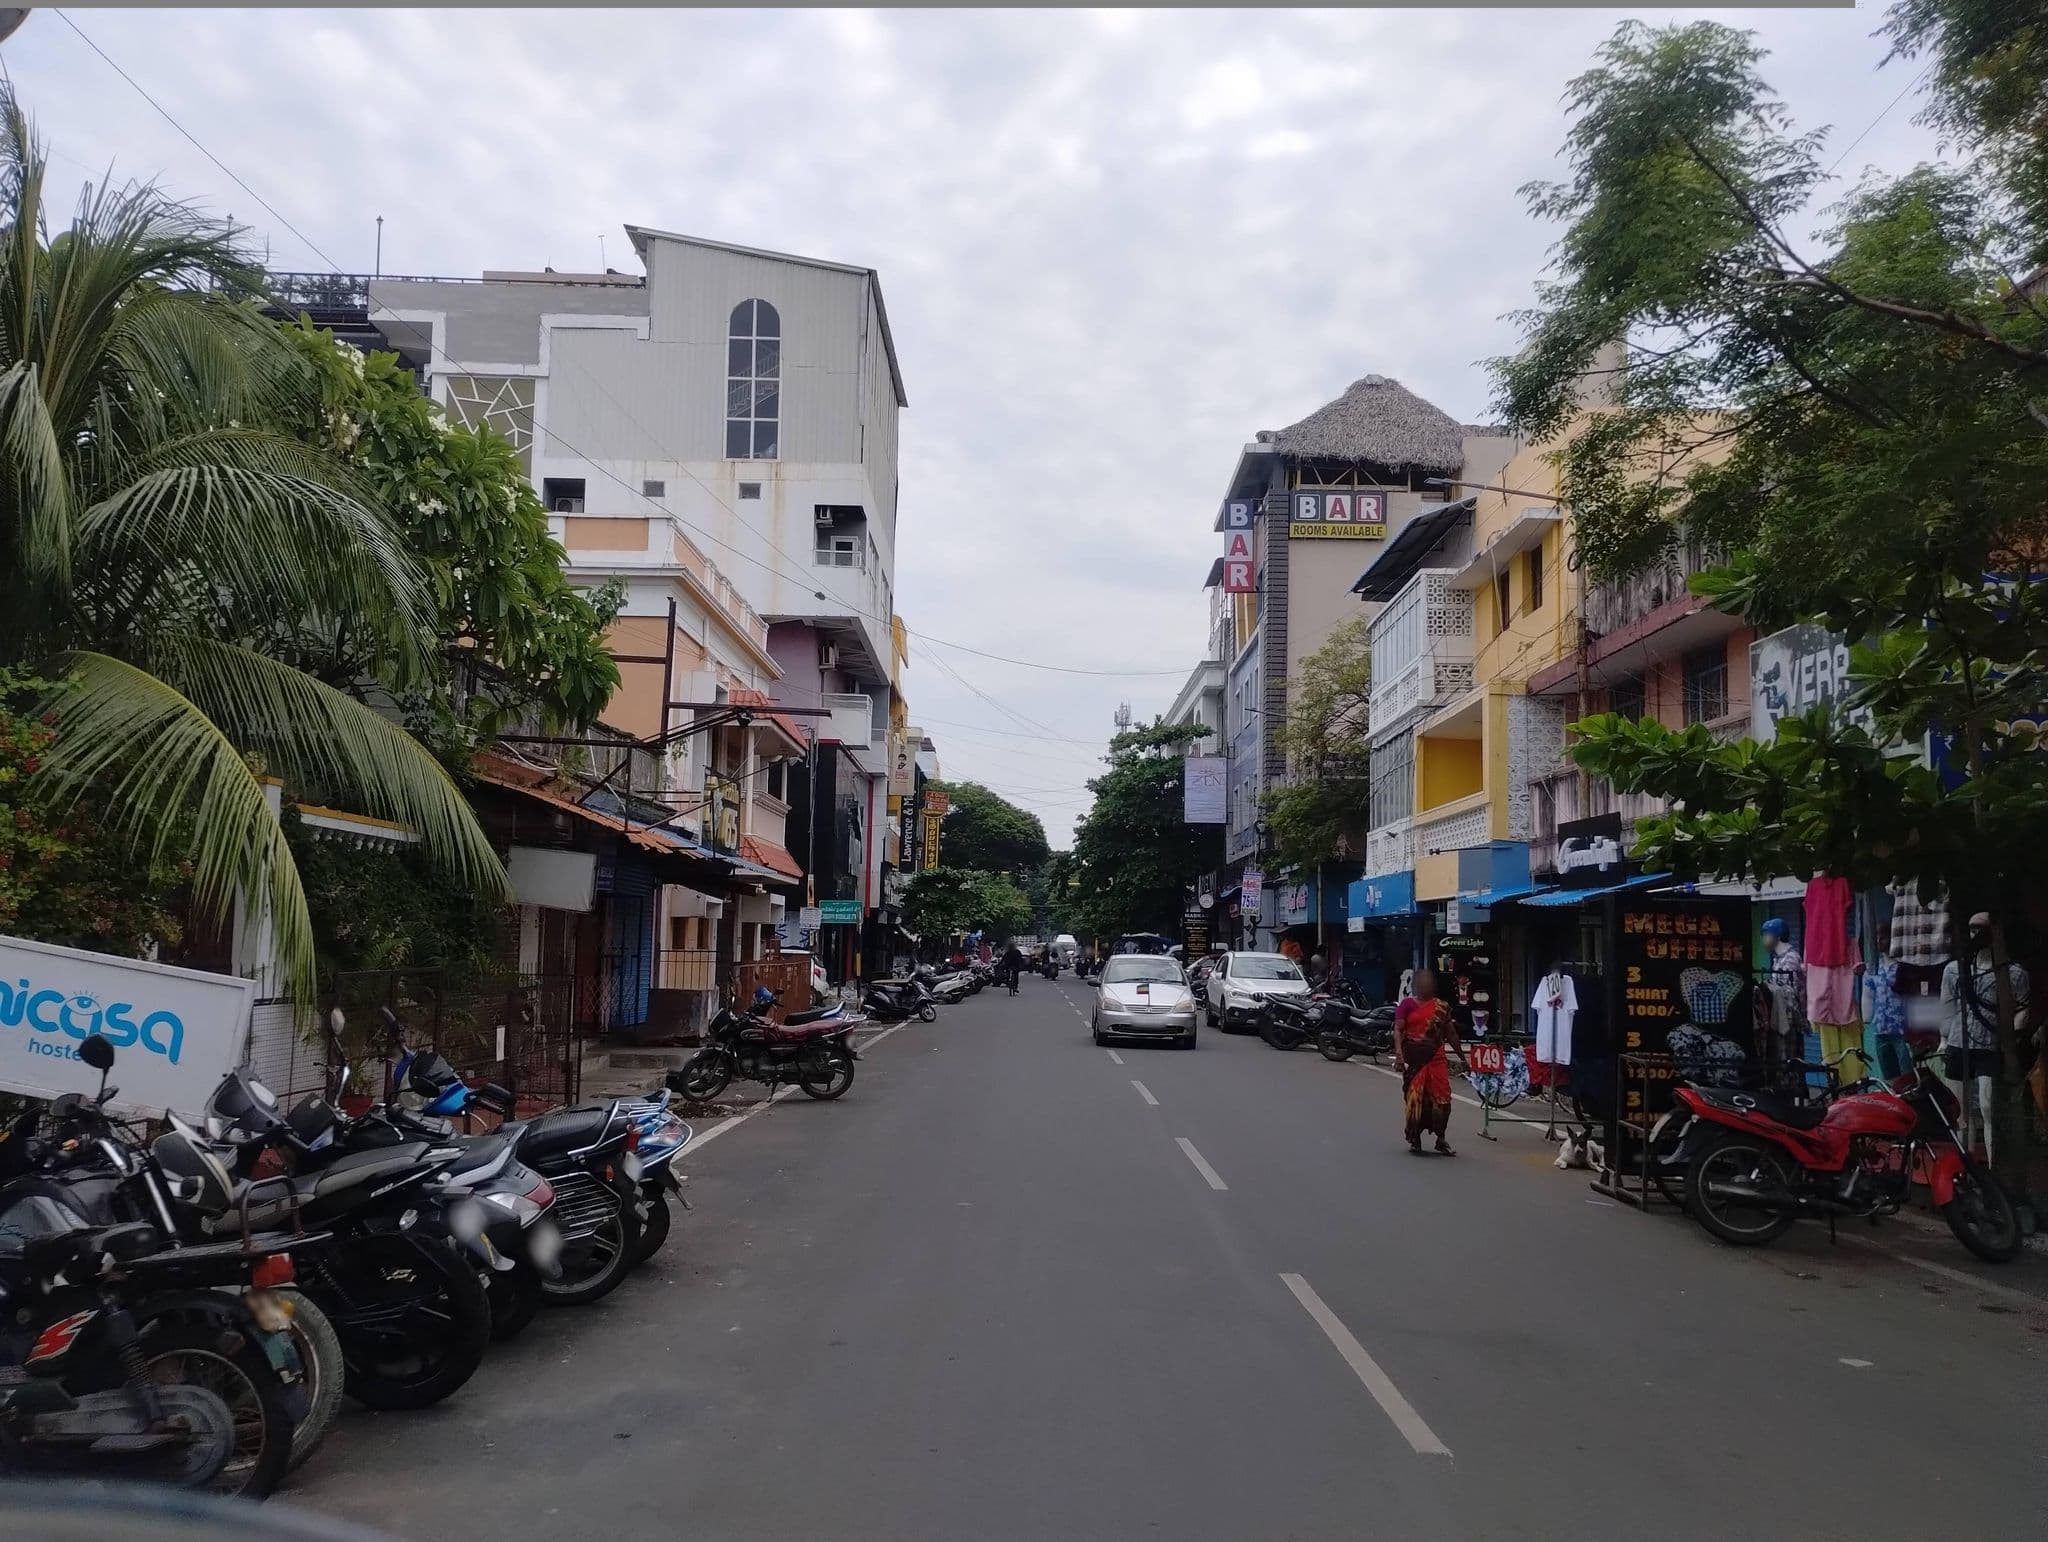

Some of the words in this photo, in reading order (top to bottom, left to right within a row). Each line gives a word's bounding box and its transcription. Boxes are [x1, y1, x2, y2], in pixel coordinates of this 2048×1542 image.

[1300, 497, 1378, 519] BAR
[1293, 525, 1328, 537] ROOMS
[1330, 525, 1383, 537] AVAILABLE
[1229, 503, 1249, 587] BAR
[903, 807, 914, 816] &
[901, 817, 914, 862] Lawrence
[1623, 912, 1721, 934] MEGA
[1646, 938, 1744, 960] OFFER
[1627, 966, 1641, 983] 3
[1626, 988, 1669, 1000] SHIRT
[1628, 1004, 1681, 1017] 1000/-
[1626, 1031, 1641, 1048] 3
[1474, 1049, 1501, 1069] 149
[1627, 1091, 1641, 1107] 3
